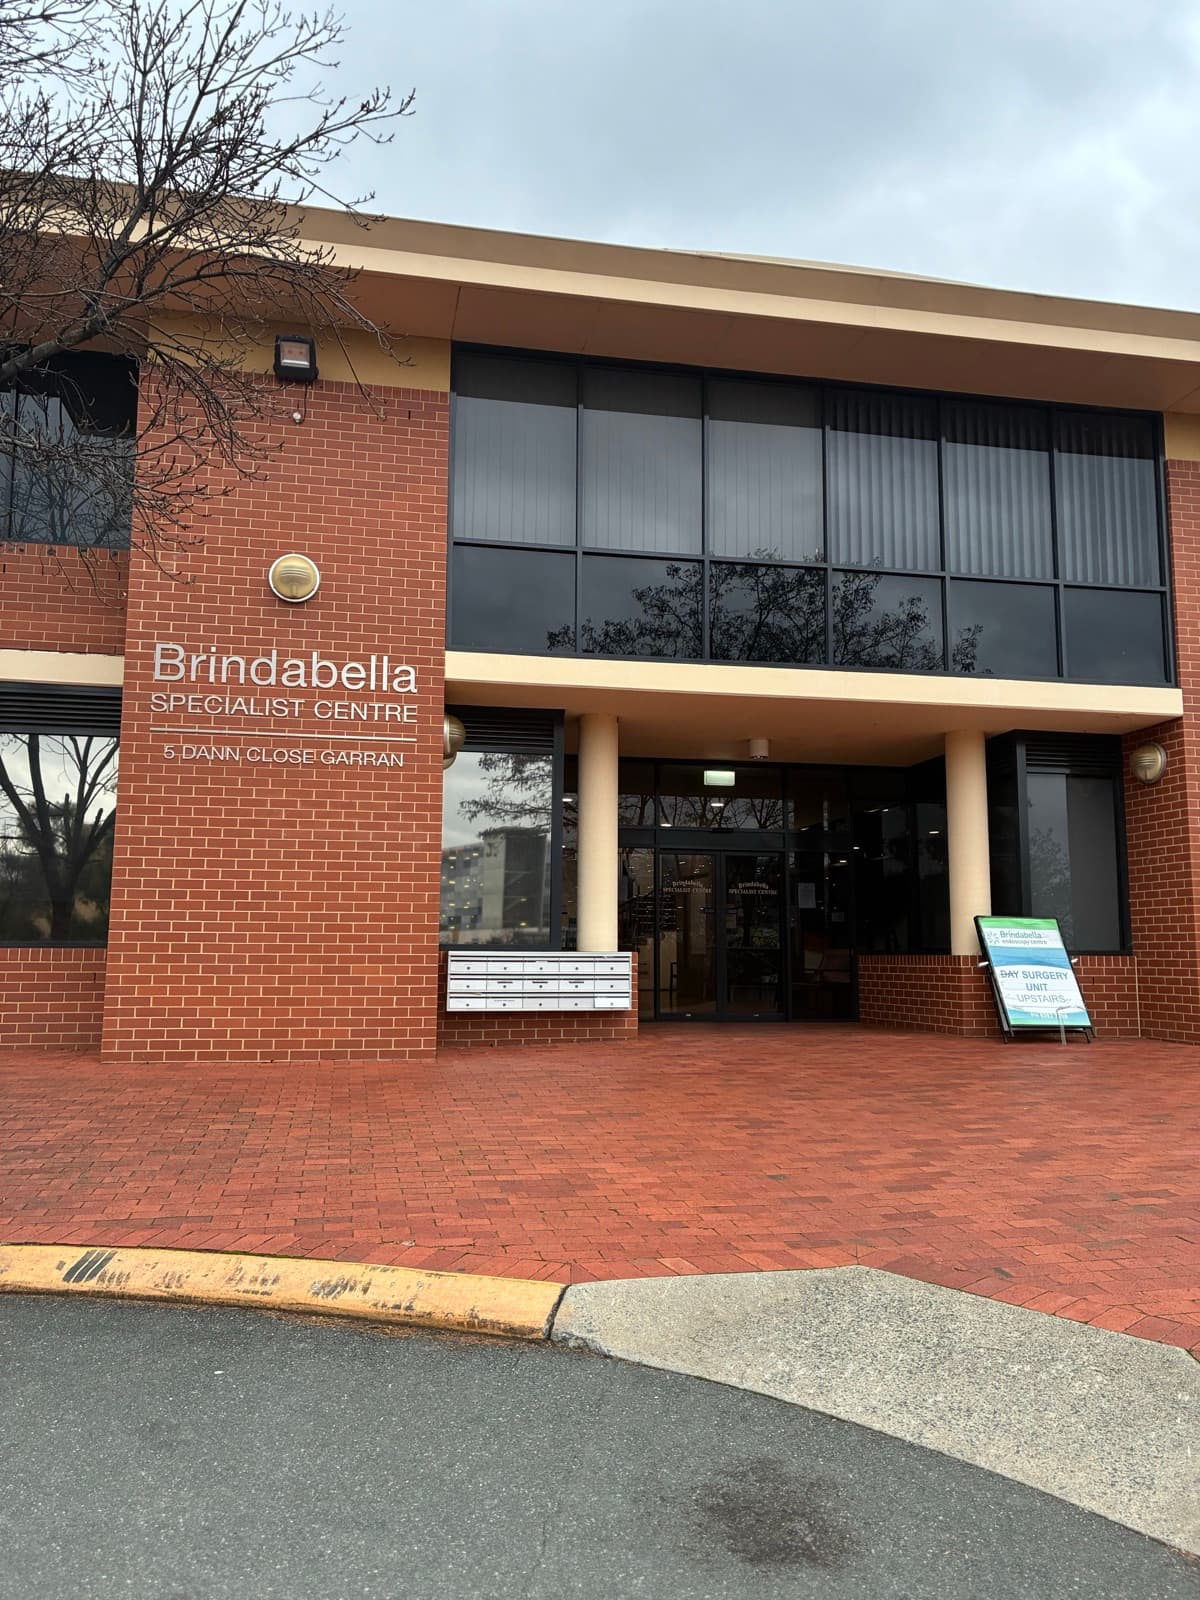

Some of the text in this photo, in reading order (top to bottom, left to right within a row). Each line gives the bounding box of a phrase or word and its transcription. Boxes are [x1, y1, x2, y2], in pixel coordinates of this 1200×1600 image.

[154, 643, 418, 693] Brindabella
[150, 693, 418, 723] SPECIALIST CENTRE
[163, 745, 404, 767] 5 DANN CLOSE GARRAN
[1000, 930, 1042, 939] Brindabella
[1000, 970, 1069, 980] DAY SURGERY
[1025, 983, 1049, 992] UNIT
[1016, 994, 1066, 1004] UPSTAIRS
